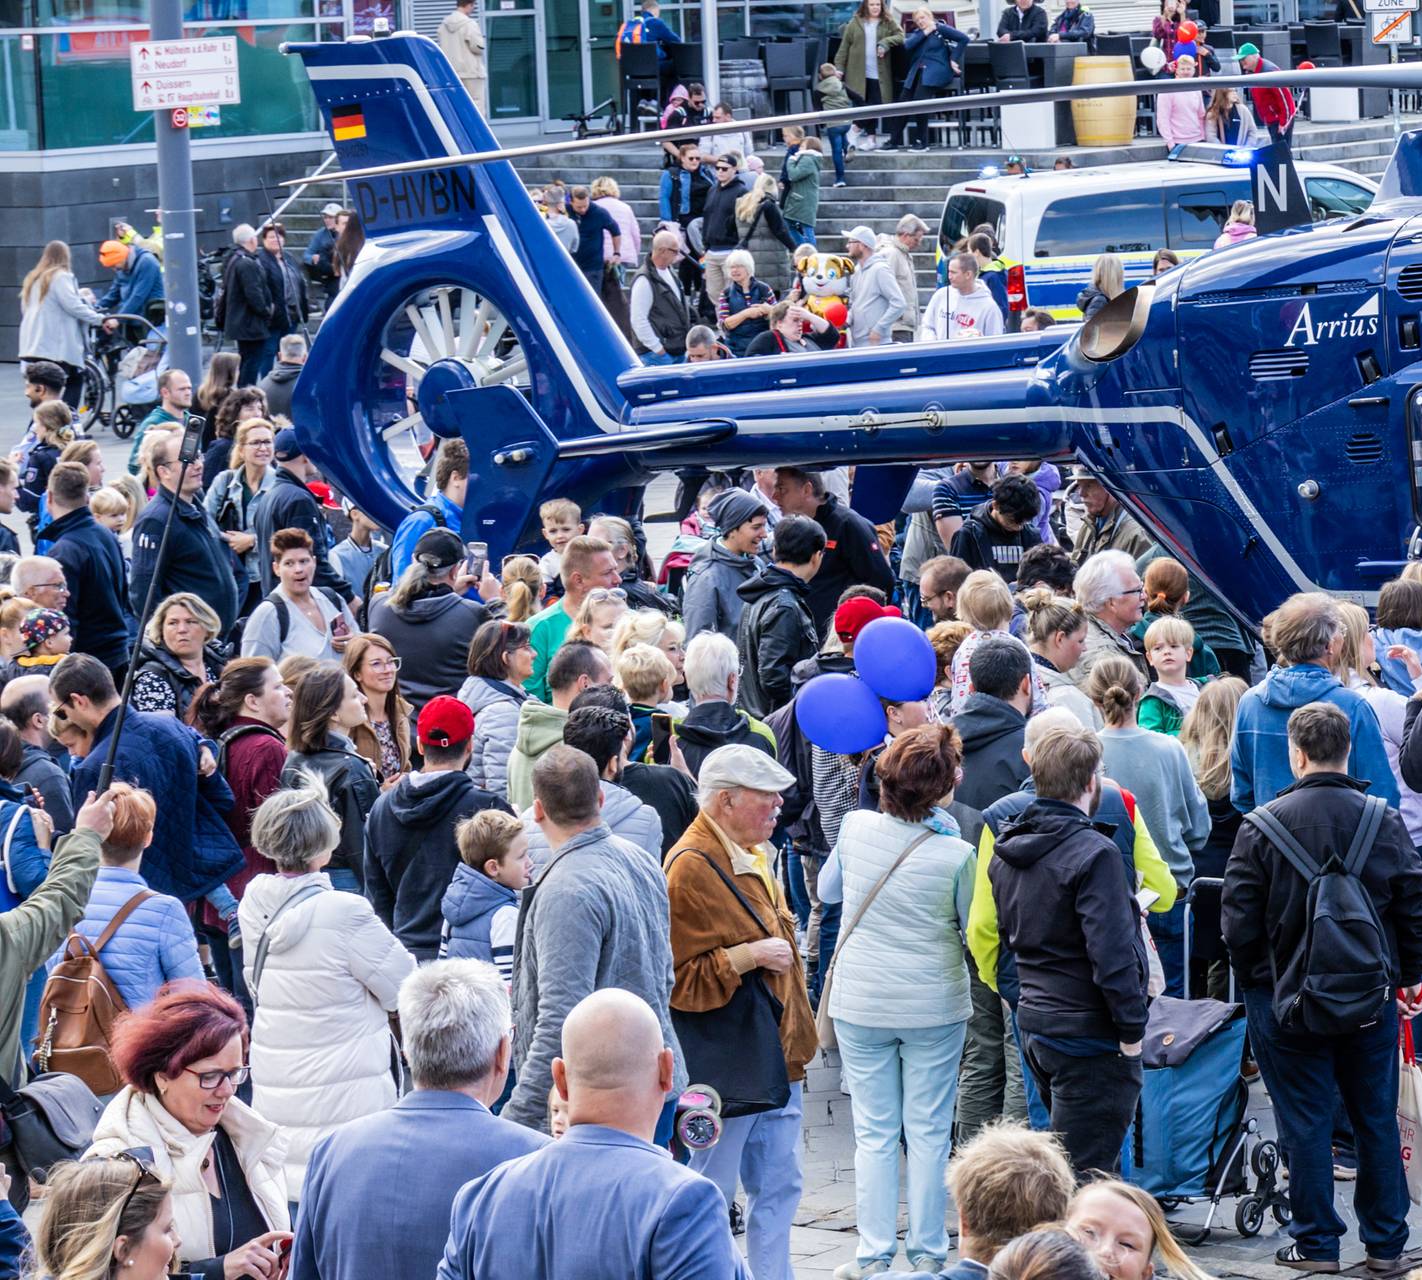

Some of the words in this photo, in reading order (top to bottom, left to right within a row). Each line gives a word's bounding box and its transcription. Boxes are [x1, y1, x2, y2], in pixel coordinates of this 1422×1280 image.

[155, 60, 186, 69] Neudorf
[356, 171, 476, 224] D-HVBN
[1257, 164, 1287, 212] N
[1284, 302, 1379, 346] Arrius
